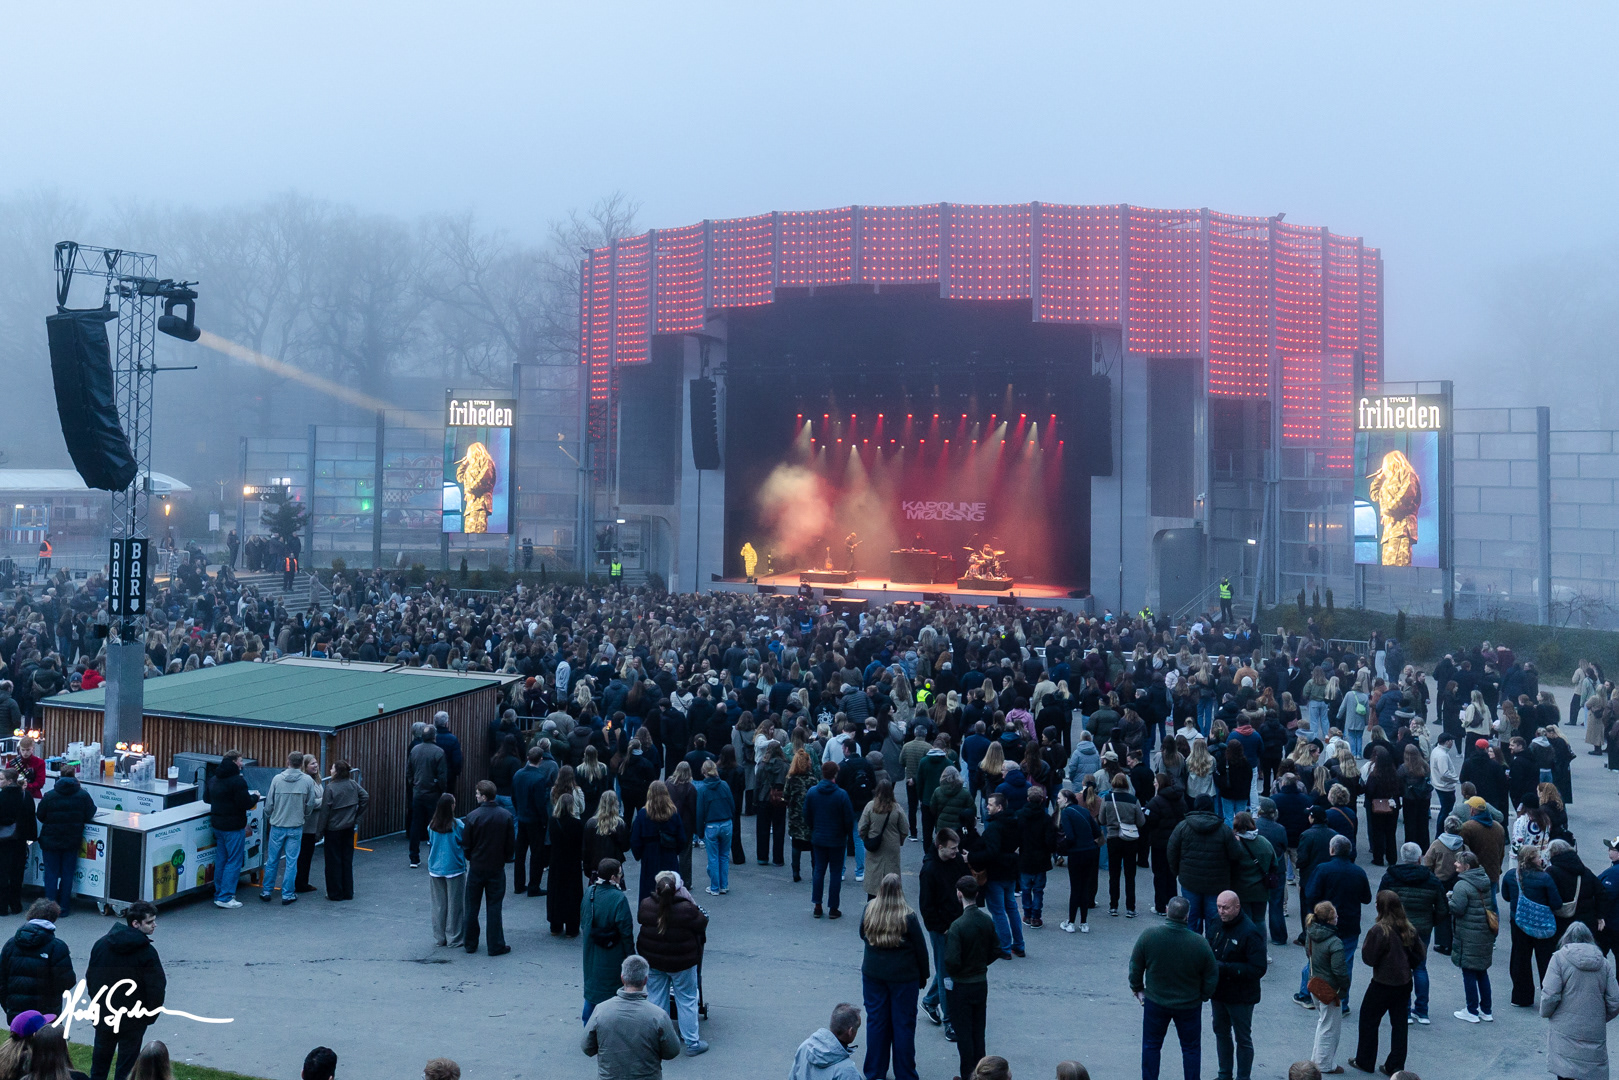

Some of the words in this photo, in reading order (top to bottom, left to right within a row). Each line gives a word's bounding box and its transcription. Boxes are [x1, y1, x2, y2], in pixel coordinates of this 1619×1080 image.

[449, 400, 513, 426] friheden
[1359, 397, 1440, 429] friheden
[112, 542, 120, 596] BAR
[130, 542, 141, 596] BAR
[85, 825, 100, 833] CKTAILS
[172, 854, 184, 865] 60
